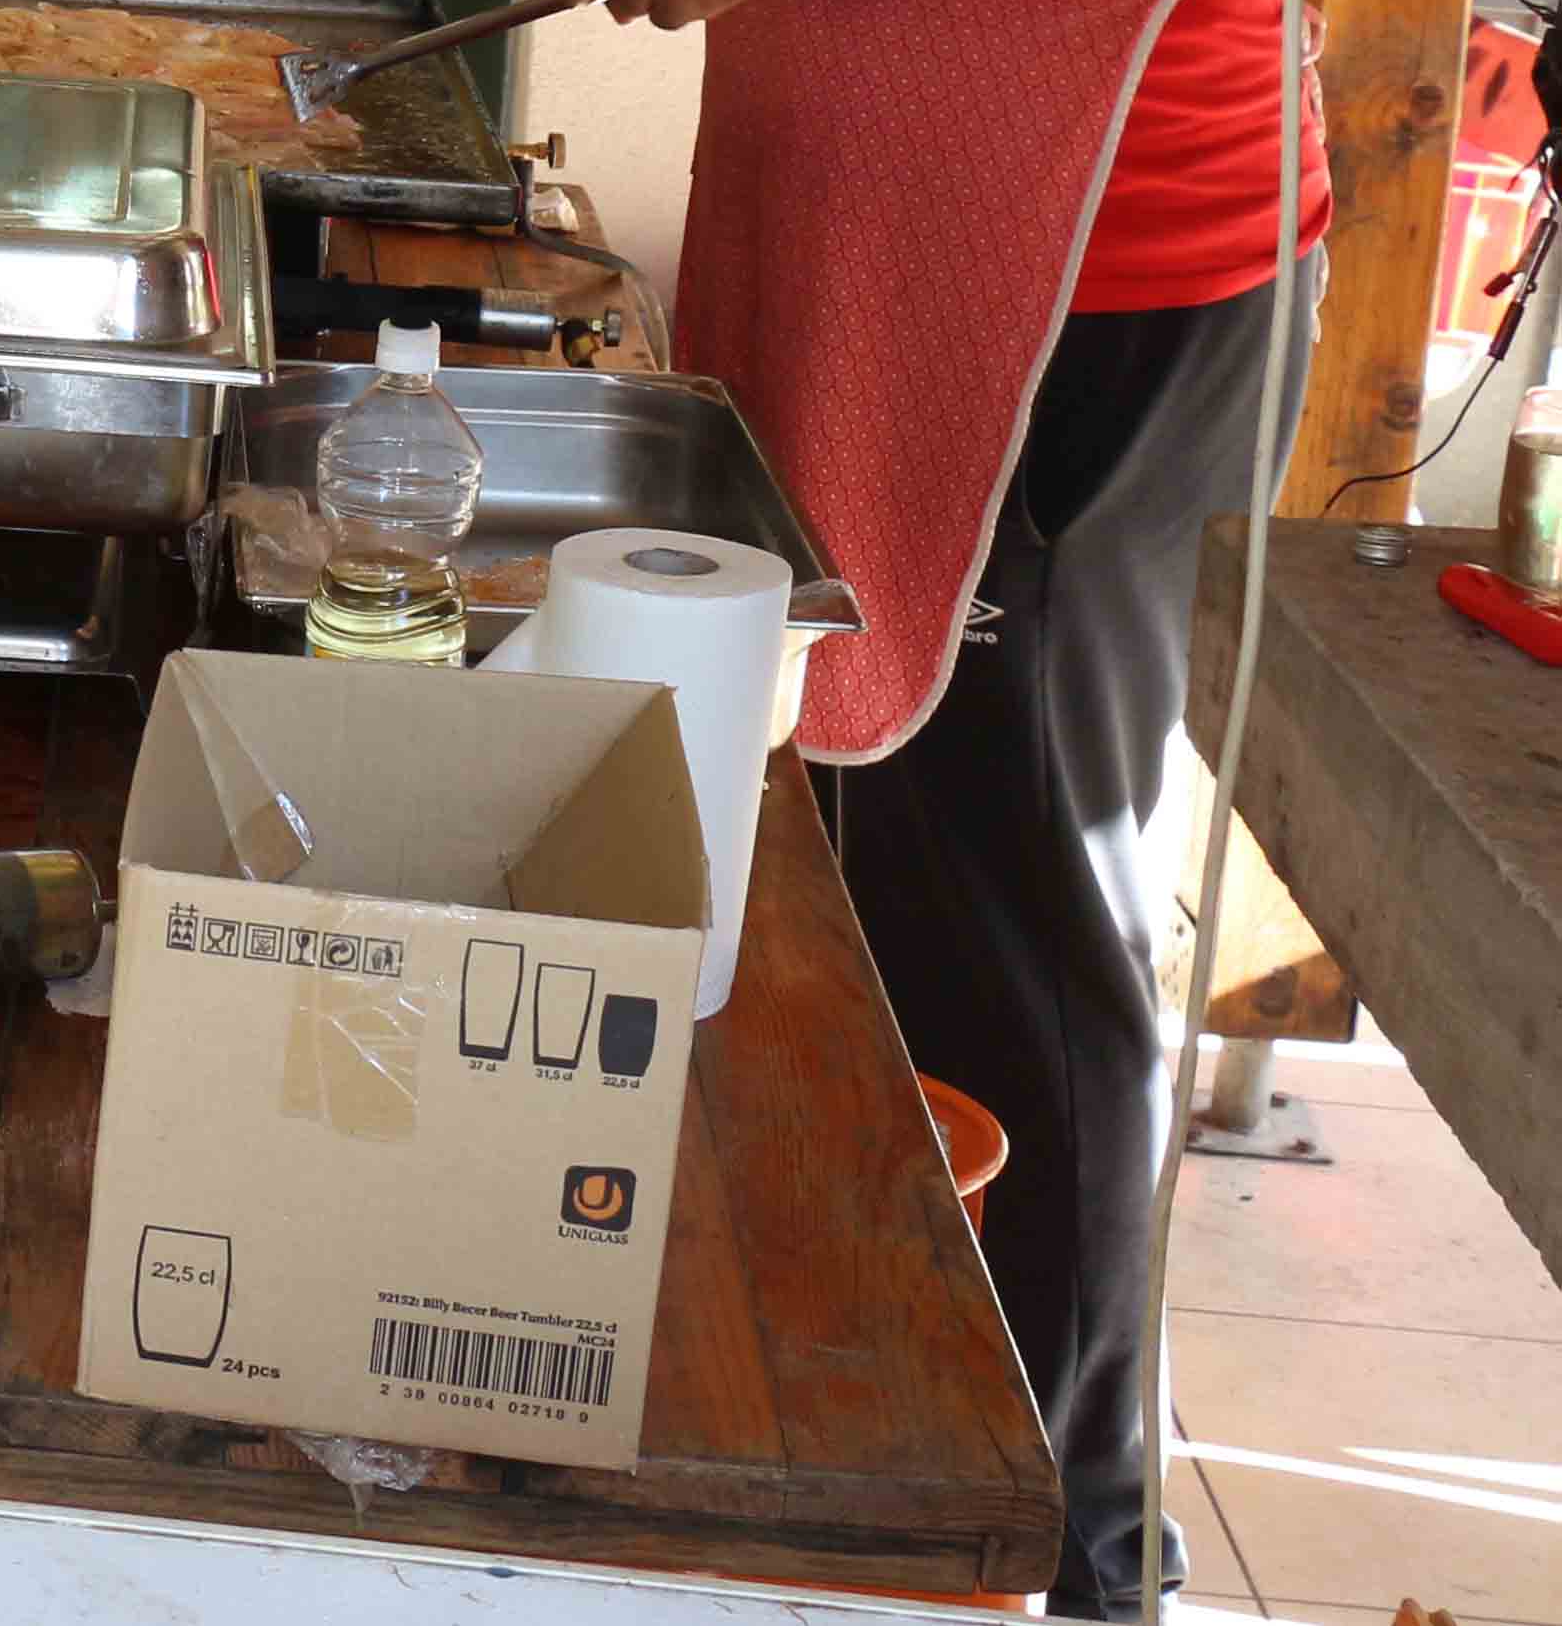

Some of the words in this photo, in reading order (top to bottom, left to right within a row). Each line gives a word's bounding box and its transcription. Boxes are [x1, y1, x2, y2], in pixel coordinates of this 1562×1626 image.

[964, 629, 998, 644] bro
[151, 1261, 194, 1283] 22,5
[198, 1269, 215, 1286] cl
[423, 1296, 450, 1313] Billy
[521, 1310, 573, 1328] Tumbler
[221, 1357, 244, 1373] 24
[247, 1364, 281, 1379] pcs
